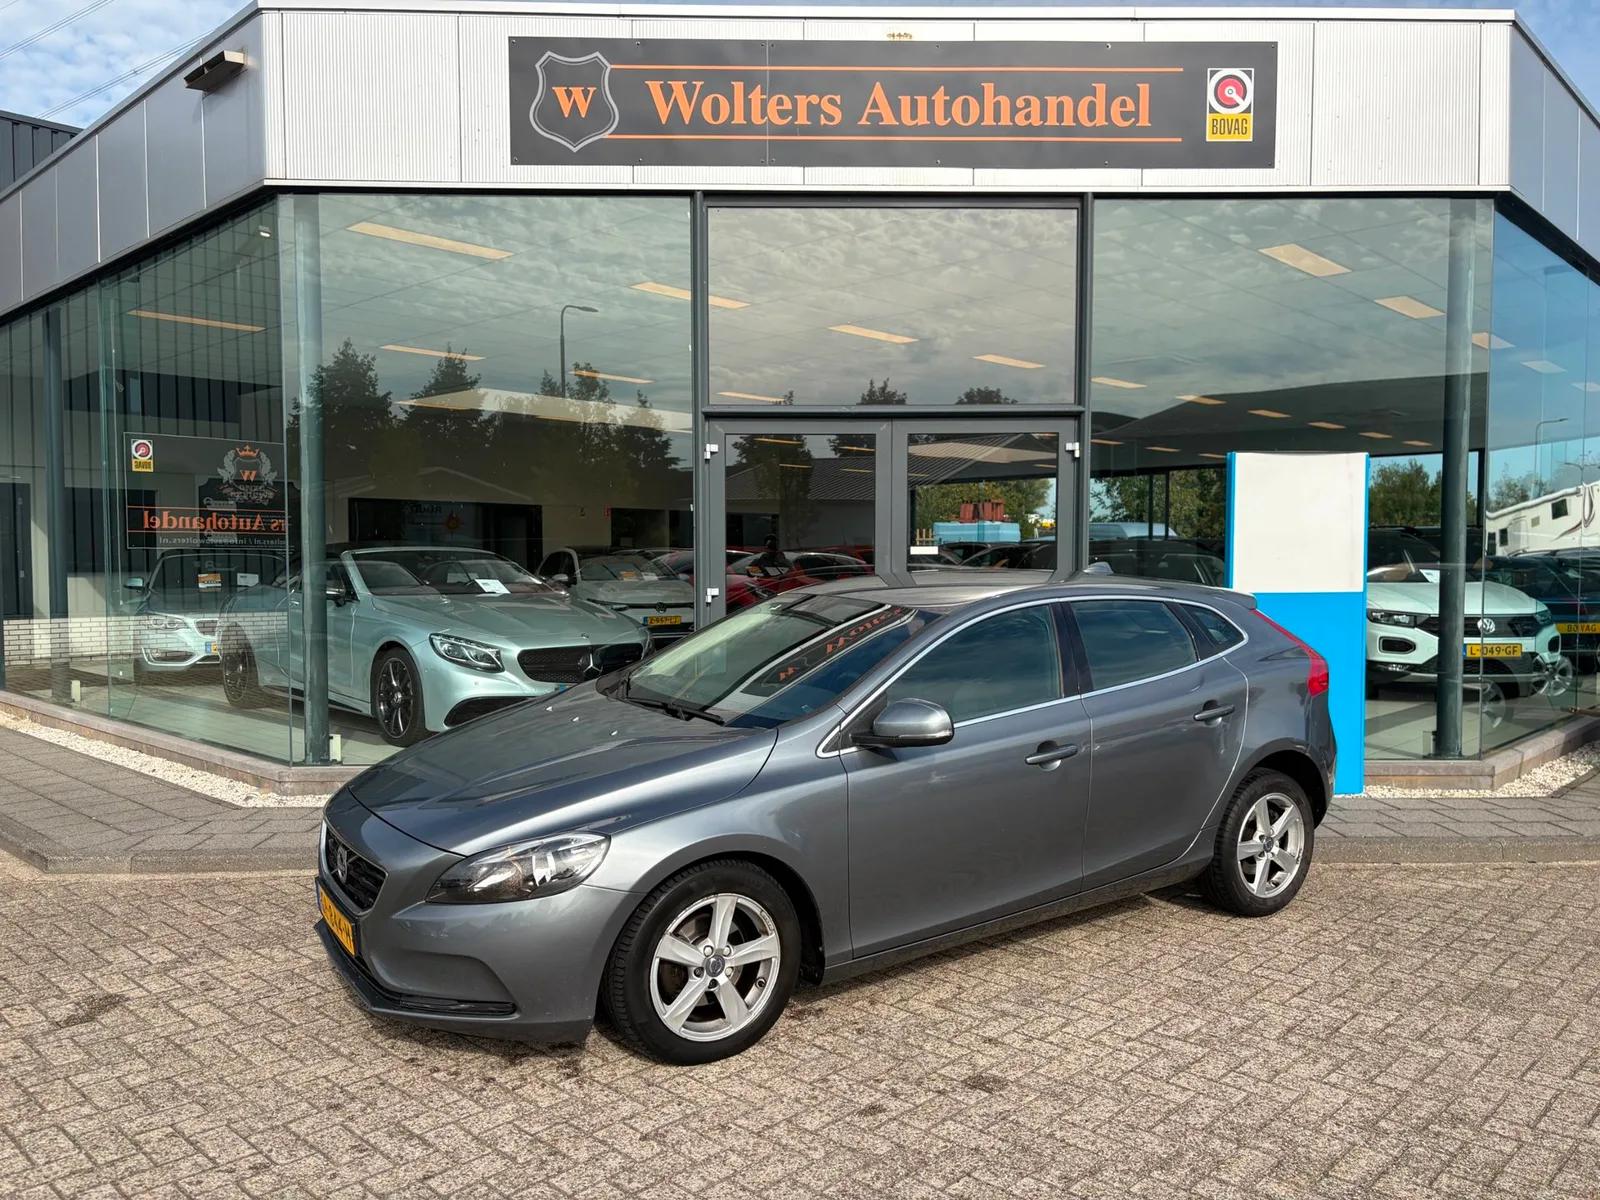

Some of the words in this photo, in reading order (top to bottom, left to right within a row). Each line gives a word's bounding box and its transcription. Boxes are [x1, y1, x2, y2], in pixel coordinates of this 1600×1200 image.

[552, 86, 597, 119] W
[645, 80, 843, 126] Wolters
[857, 81, 1152, 128] Autohandel
[1210, 117, 1249, 136] BOVAG
[1469, 645, 1519, 657] L-049-GF
